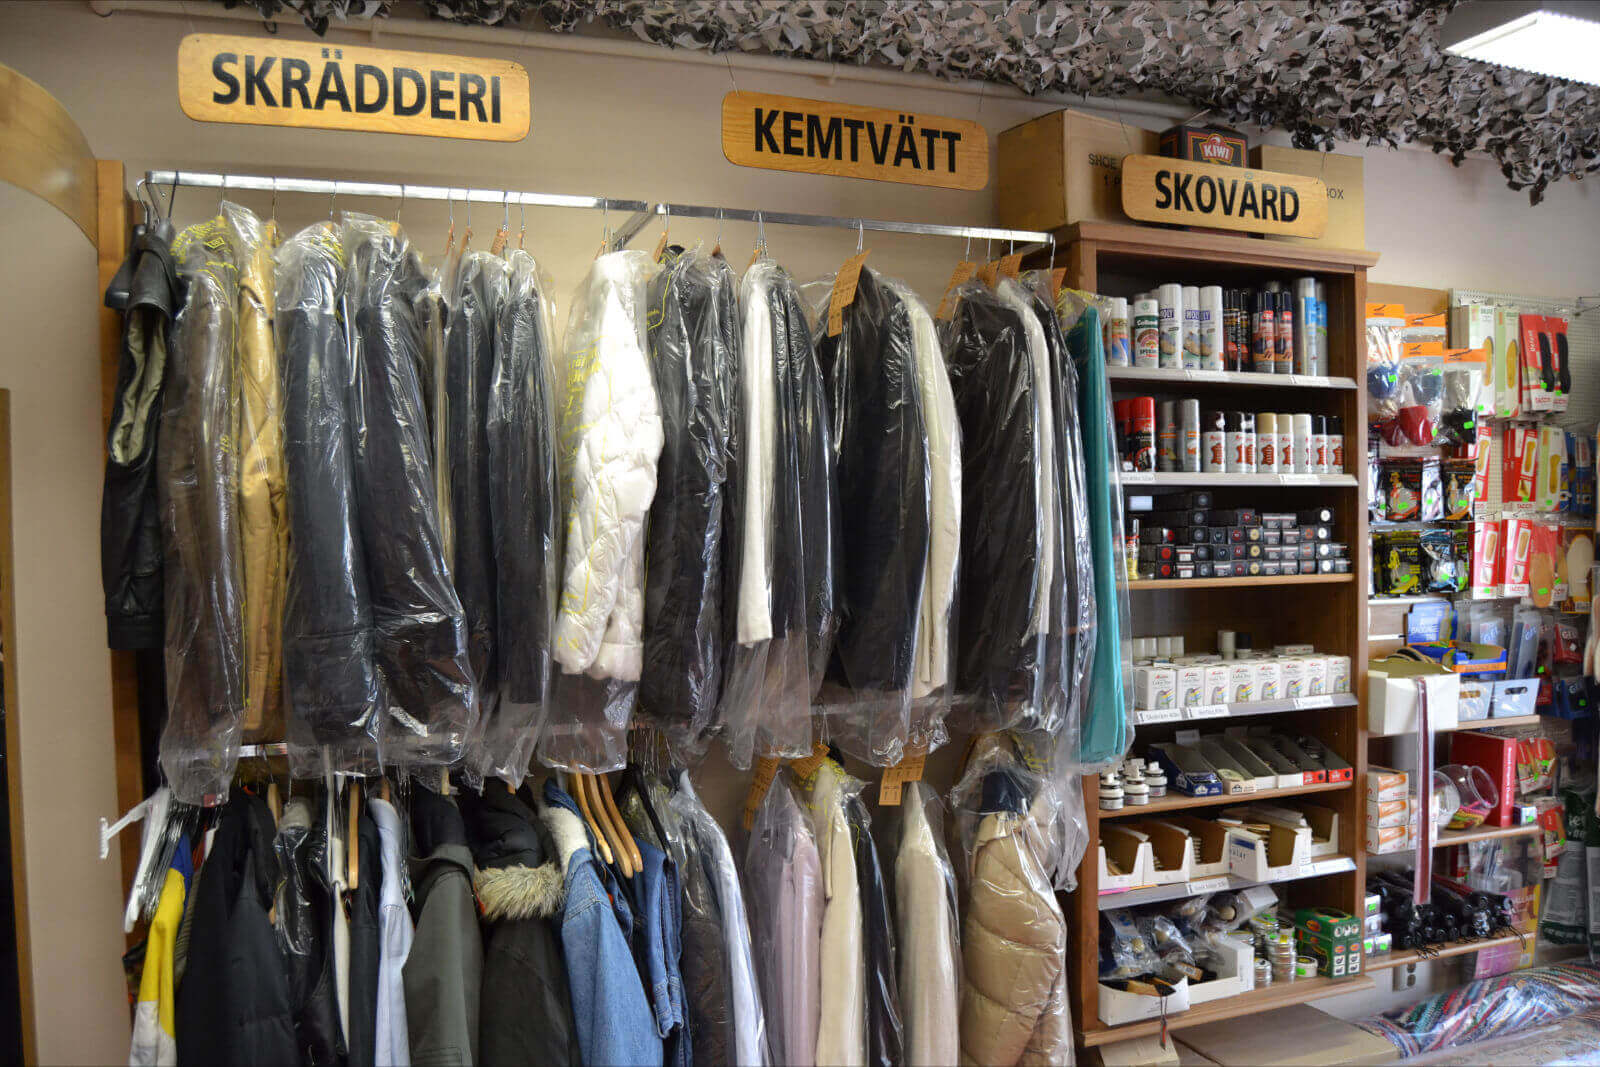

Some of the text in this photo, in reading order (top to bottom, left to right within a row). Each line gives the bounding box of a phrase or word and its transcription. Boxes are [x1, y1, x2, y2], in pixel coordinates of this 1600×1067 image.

[211, 47, 501, 124] SKRÄDDERI
[754, 107, 961, 173] KEMTVÄTT
[1203, 142, 1230, 159] KIWI
[1088, 153, 1118, 171] SHOE
[1154, 171, 1300, 222] SKOVÅRD
[1326, 188, 1344, 200] OX
